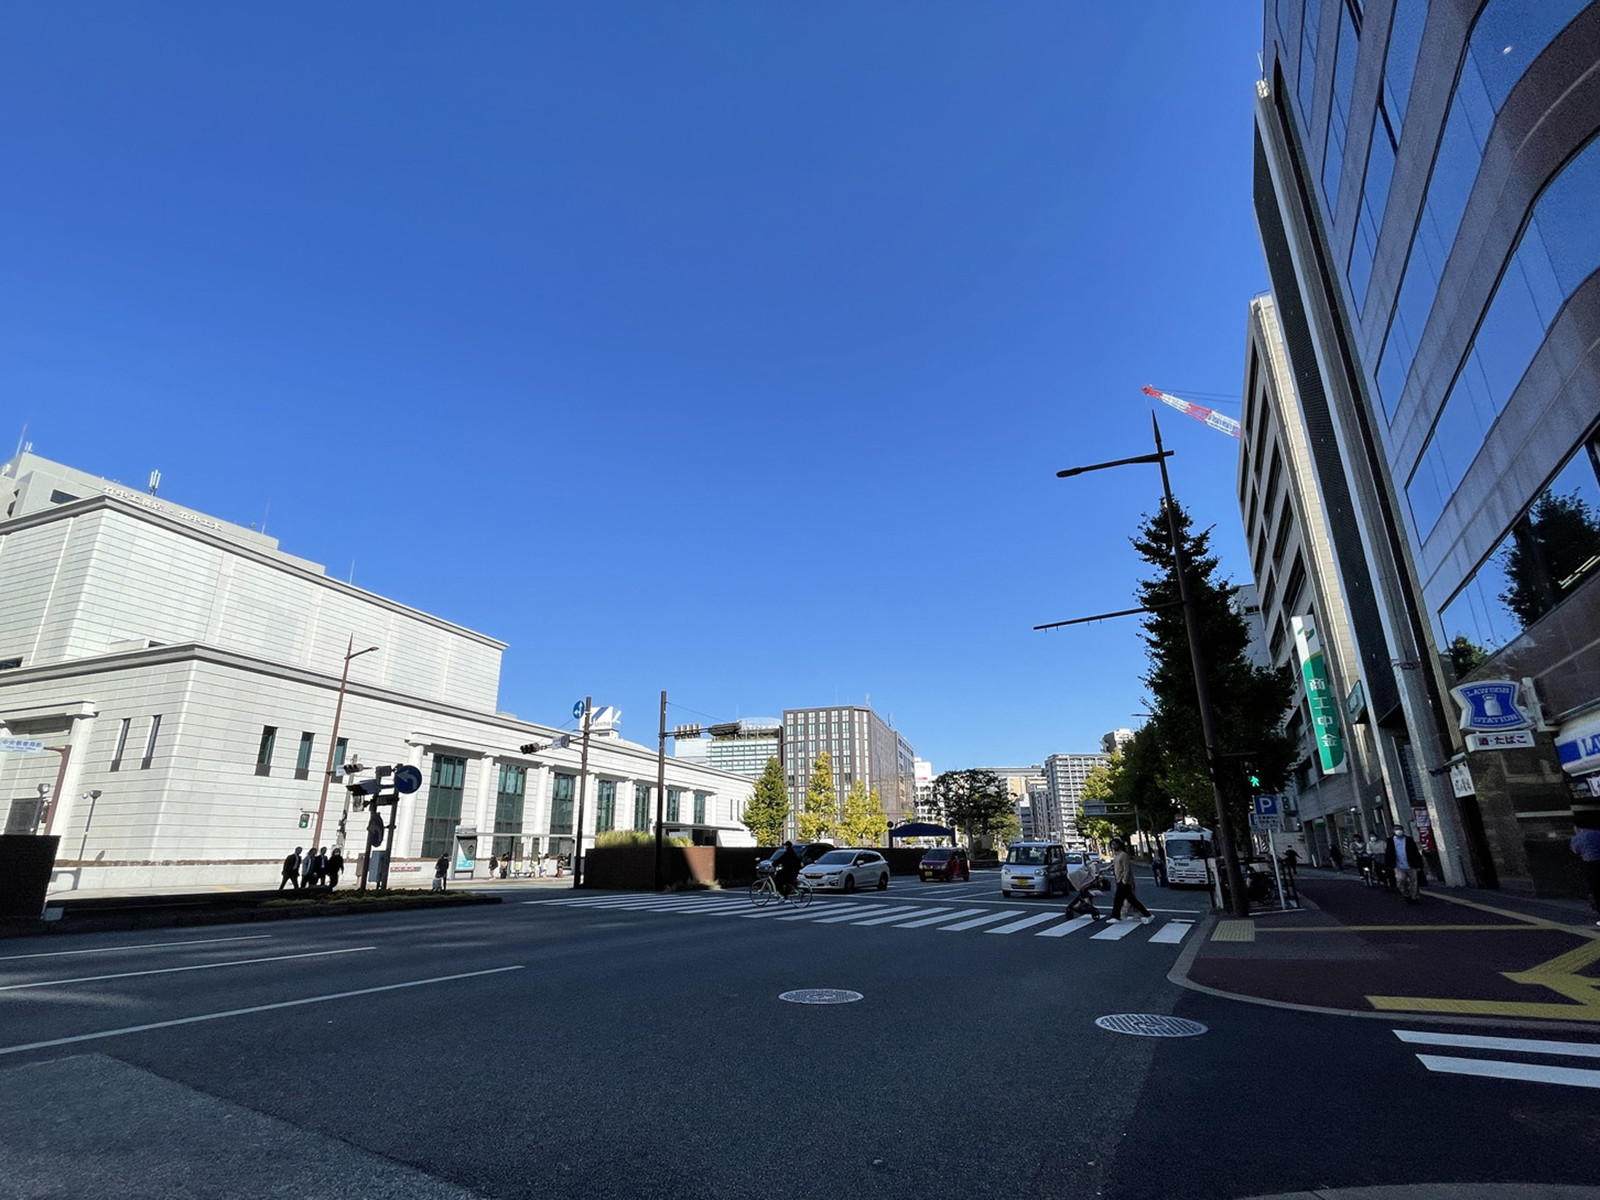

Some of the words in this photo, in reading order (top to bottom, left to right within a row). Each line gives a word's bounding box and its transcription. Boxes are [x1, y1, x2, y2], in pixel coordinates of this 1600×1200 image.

[1466, 687, 1510, 697] LAWSON
[1308, 678, 1337, 747] 商工中金
[1474, 714, 1518, 724] STATION
[1259, 797, 1272, 813] P
